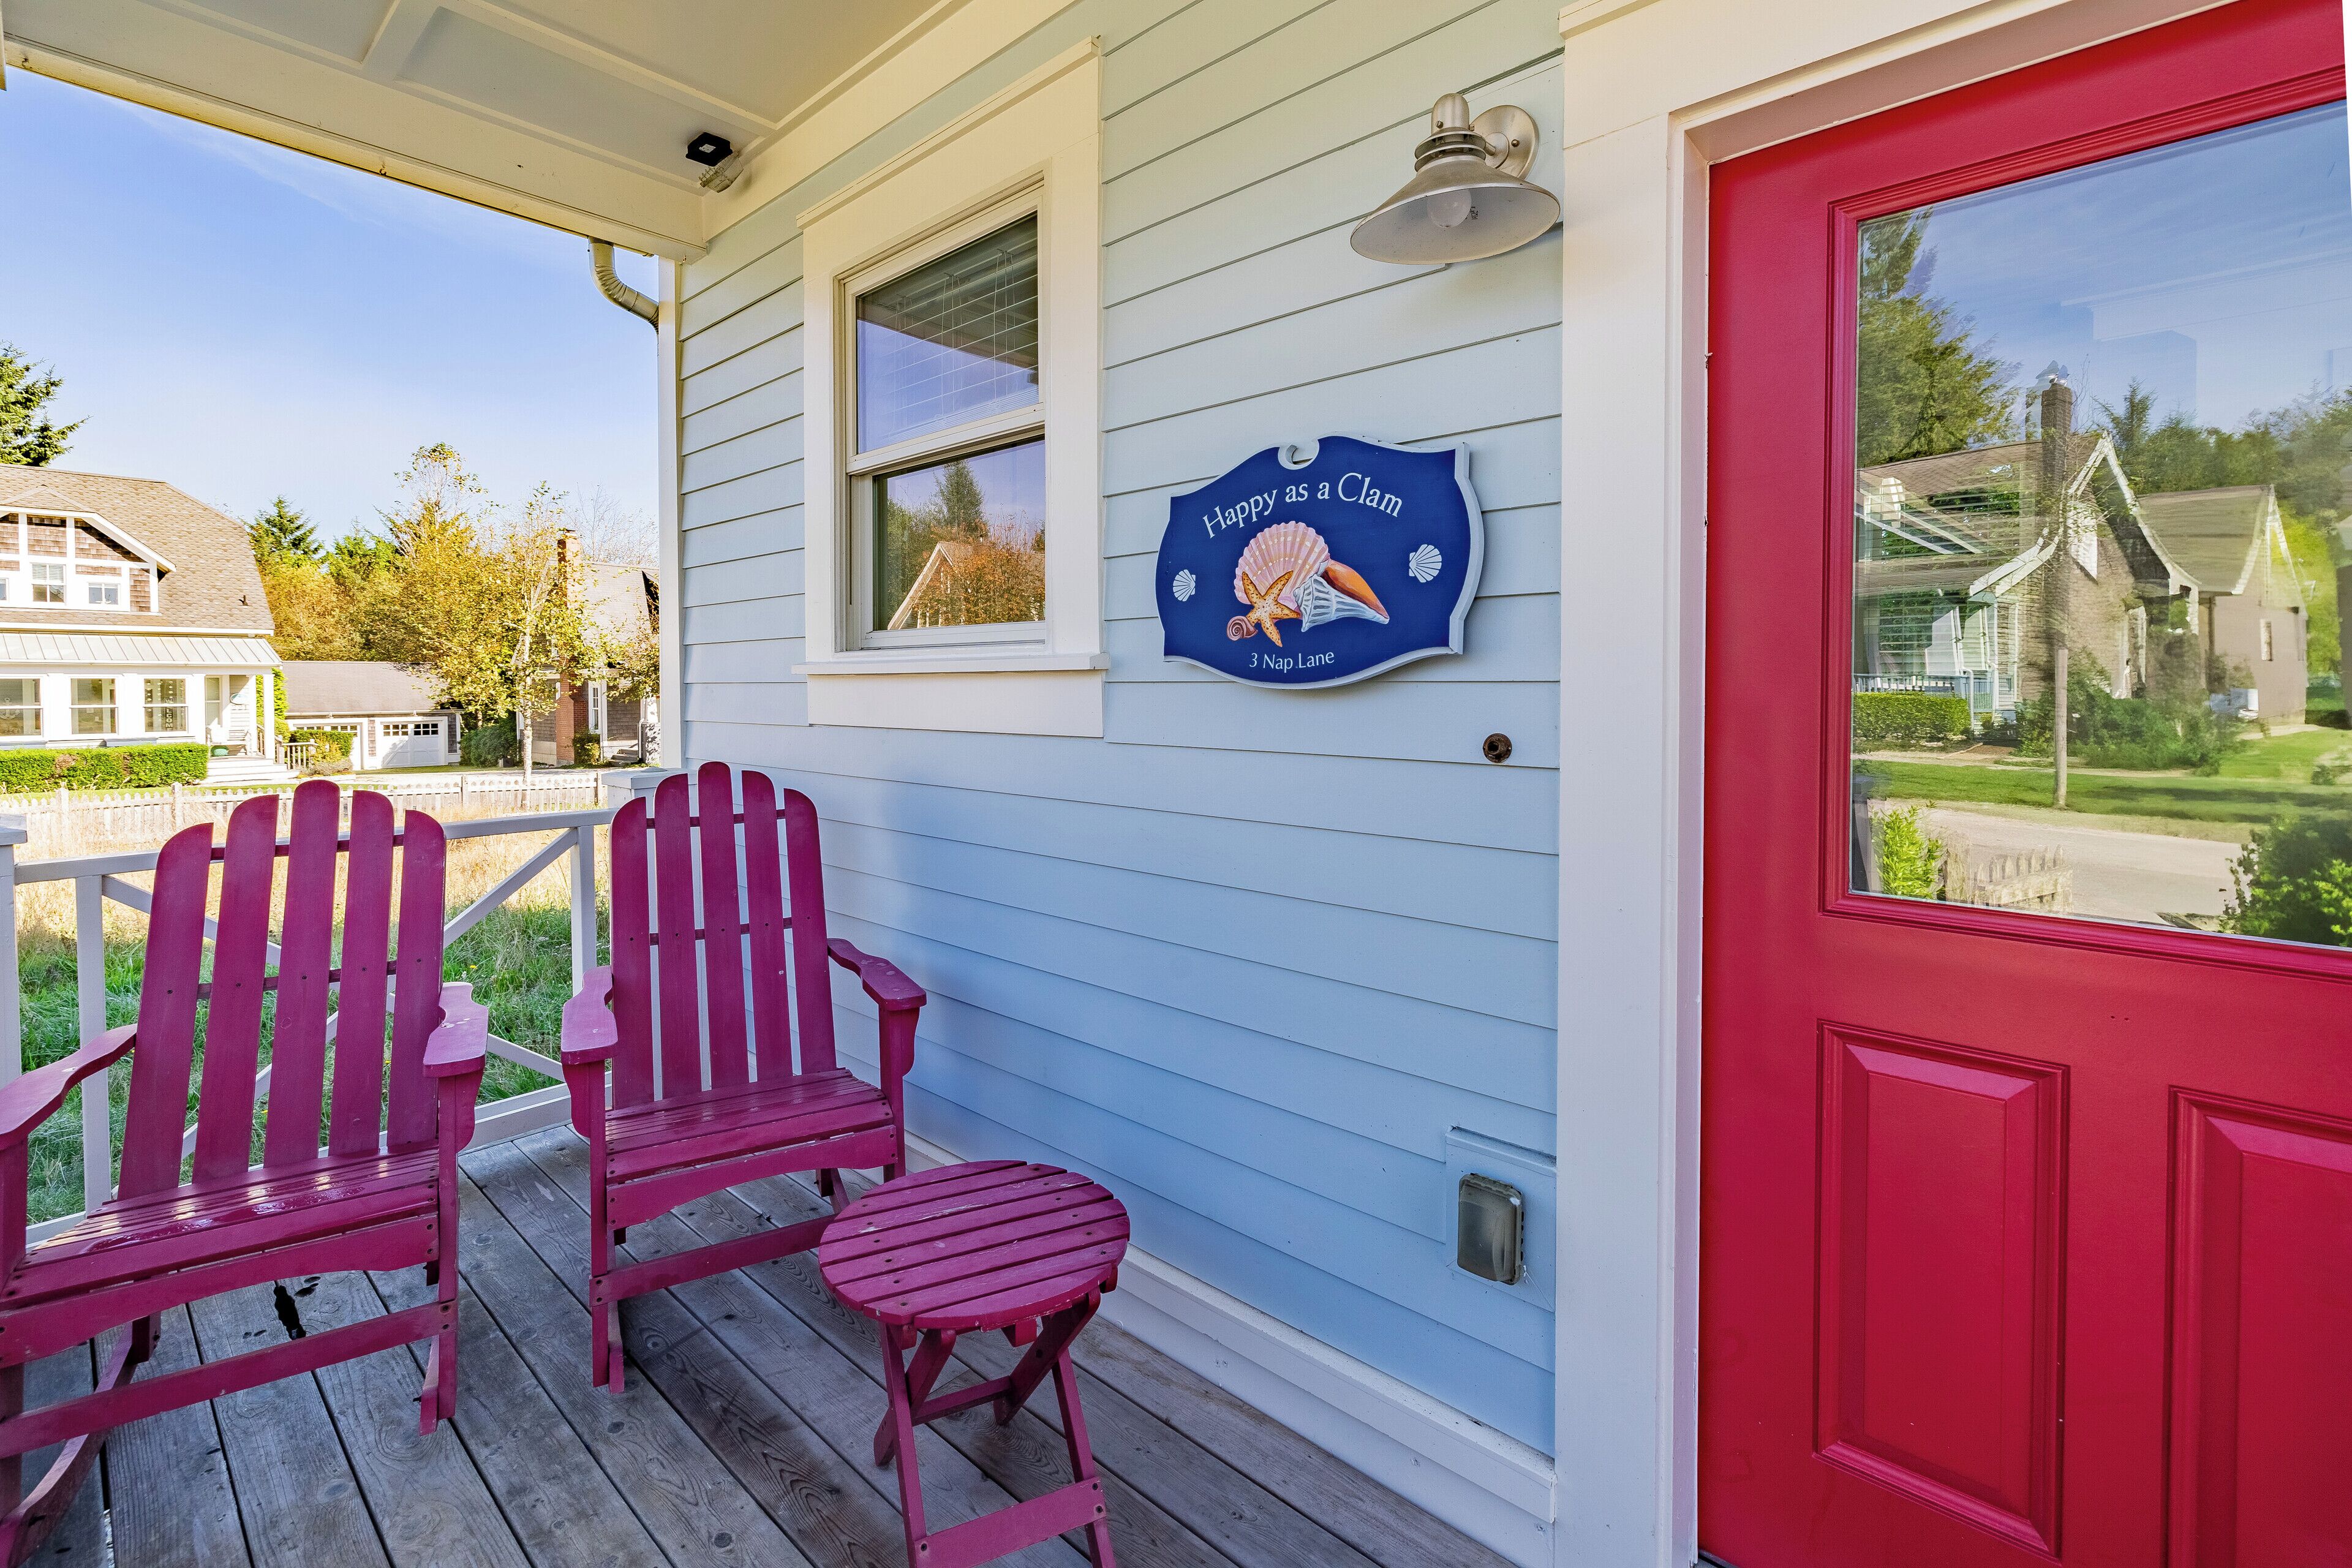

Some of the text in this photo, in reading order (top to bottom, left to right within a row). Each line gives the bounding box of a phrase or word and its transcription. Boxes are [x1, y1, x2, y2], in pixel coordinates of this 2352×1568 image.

[1202, 472, 1403, 538] Happy as a Clam
[1249, 652, 1335, 673] 3 Nap Lane
